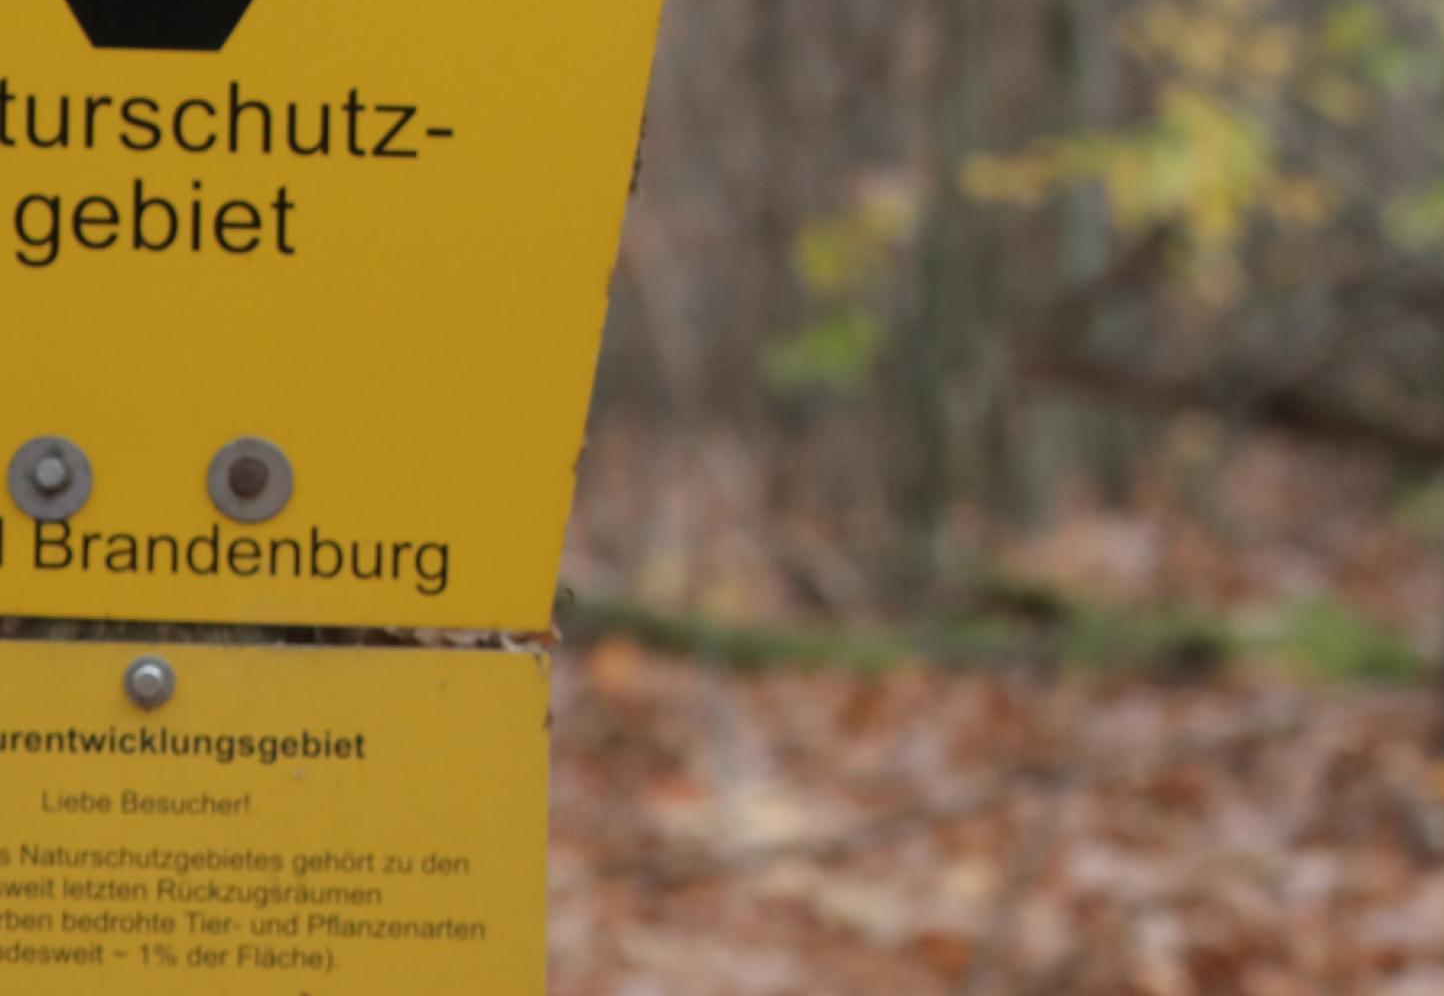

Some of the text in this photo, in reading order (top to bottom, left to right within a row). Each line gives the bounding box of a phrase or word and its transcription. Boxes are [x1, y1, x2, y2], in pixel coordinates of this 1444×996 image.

[14, 179, 296, 268] gebiet
[33, 519, 450, 596] Brandenburg
[41, 788, 252, 816] Liebe Besucher!
[19, 843, 284, 874] Naturschutzgebietes
[291, 849, 375, 877] gehört
[383, 854, 415, 874] zu
[421, 852, 470, 875] den
[0, 878, 383, 908] weit letzten Rückzugsräumen
[61, 911, 176, 933] bedrohte
[186, 911, 241, 934] Tier-
[250, 915, 299, 938] und
[307, 913, 486, 940] Pflanzenarten
[0, 941, 103, 965] desweit
[139, 943, 178, 967] 1%
[186, 945, 228, 968] der
